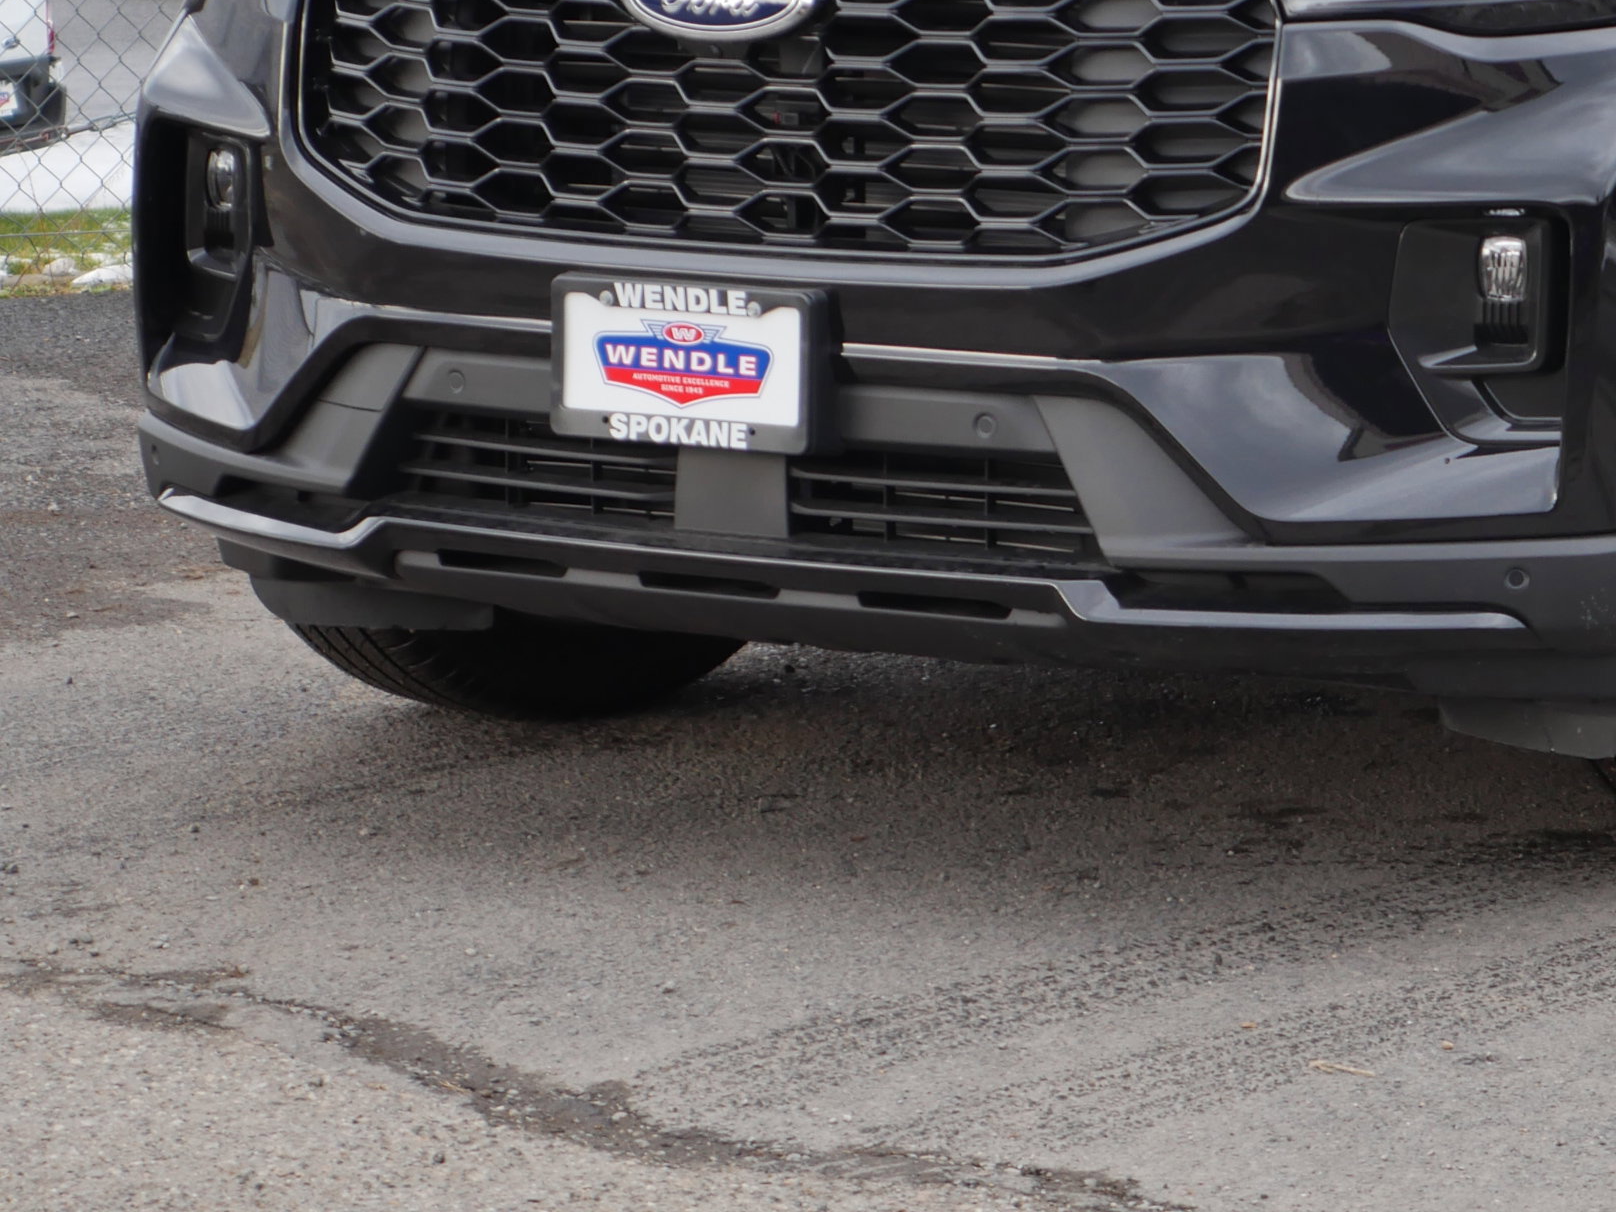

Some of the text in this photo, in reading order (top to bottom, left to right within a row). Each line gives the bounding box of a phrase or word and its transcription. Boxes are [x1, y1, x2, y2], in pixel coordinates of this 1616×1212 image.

[613, 281, 749, 317] WENDLE
[605, 343, 758, 377] WENDLE
[632, 372, 730, 388] AUTOMOTIVE EXCELLENCE
[660, 383, 683, 393] SINCE
[609, 412, 748, 449] SPOKANE
